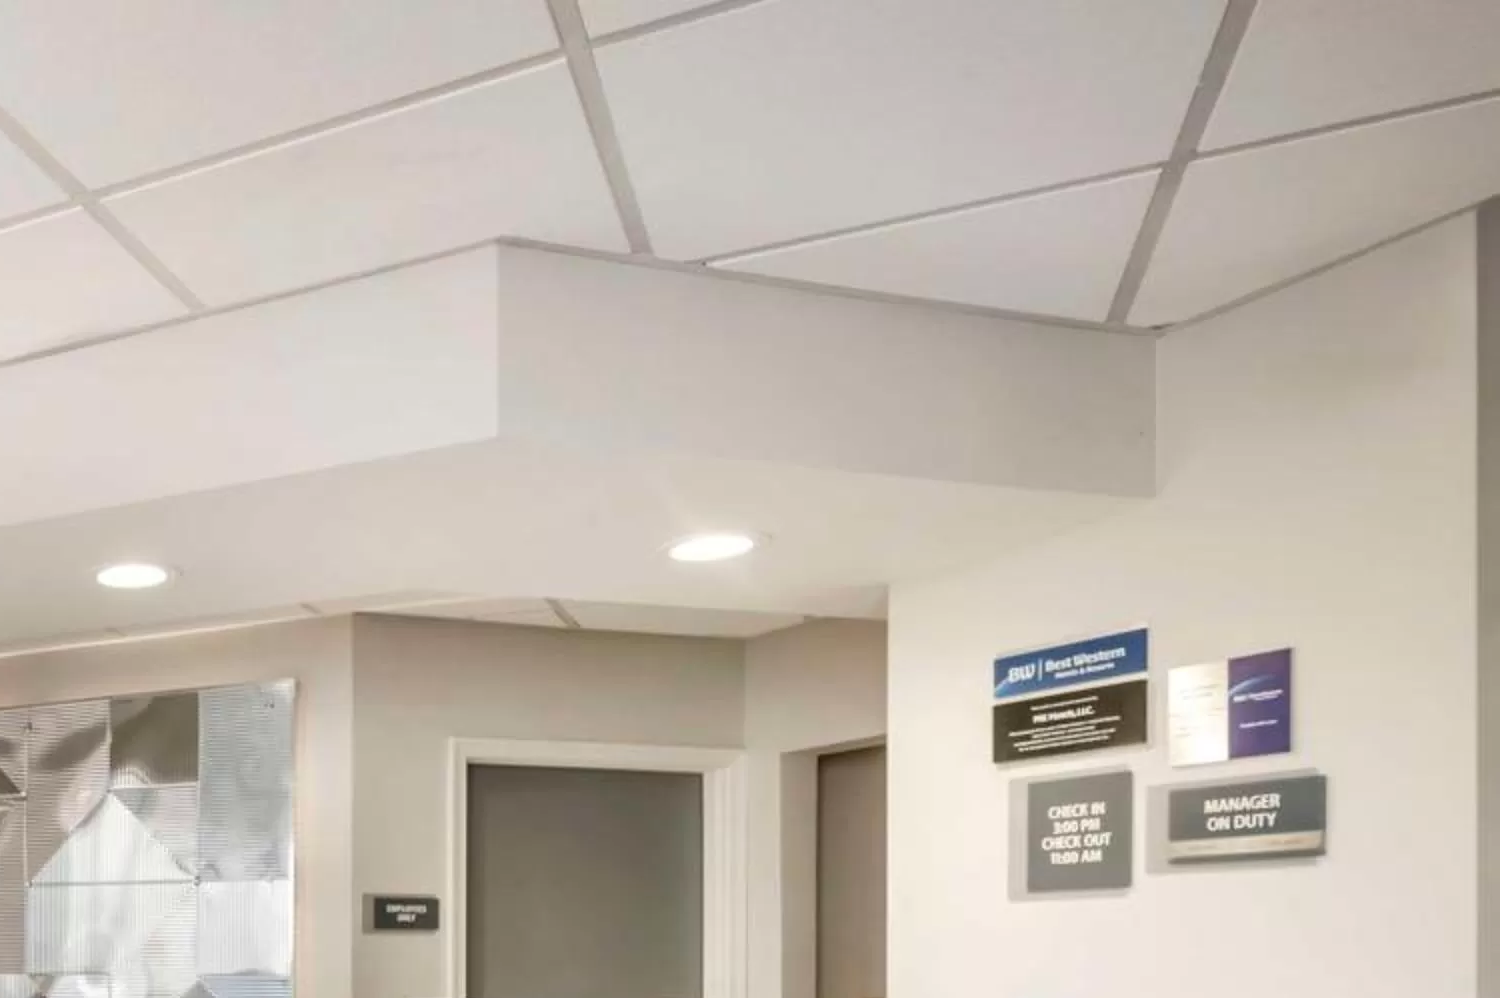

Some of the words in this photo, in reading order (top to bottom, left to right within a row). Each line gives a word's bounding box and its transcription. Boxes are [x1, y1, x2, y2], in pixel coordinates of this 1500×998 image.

[1007, 663, 1036, 683] BW
[1045, 656, 1073, 672] Best
[1073, 647, 1127, 666] Western
[1047, 803, 1088, 819] CHECK
[1090, 801, 1106, 816] IN
[1203, 793, 1282, 814] MANAGER
[1080, 818, 1101, 832] PM
[1206, 816, 1231, 832] ON
[1233, 812, 1278, 831] DUTY
[1041, 836, 1081, 850] CHECK
[1083, 831, 1112, 847] OUT
[1081, 849, 1103, 863] AM
